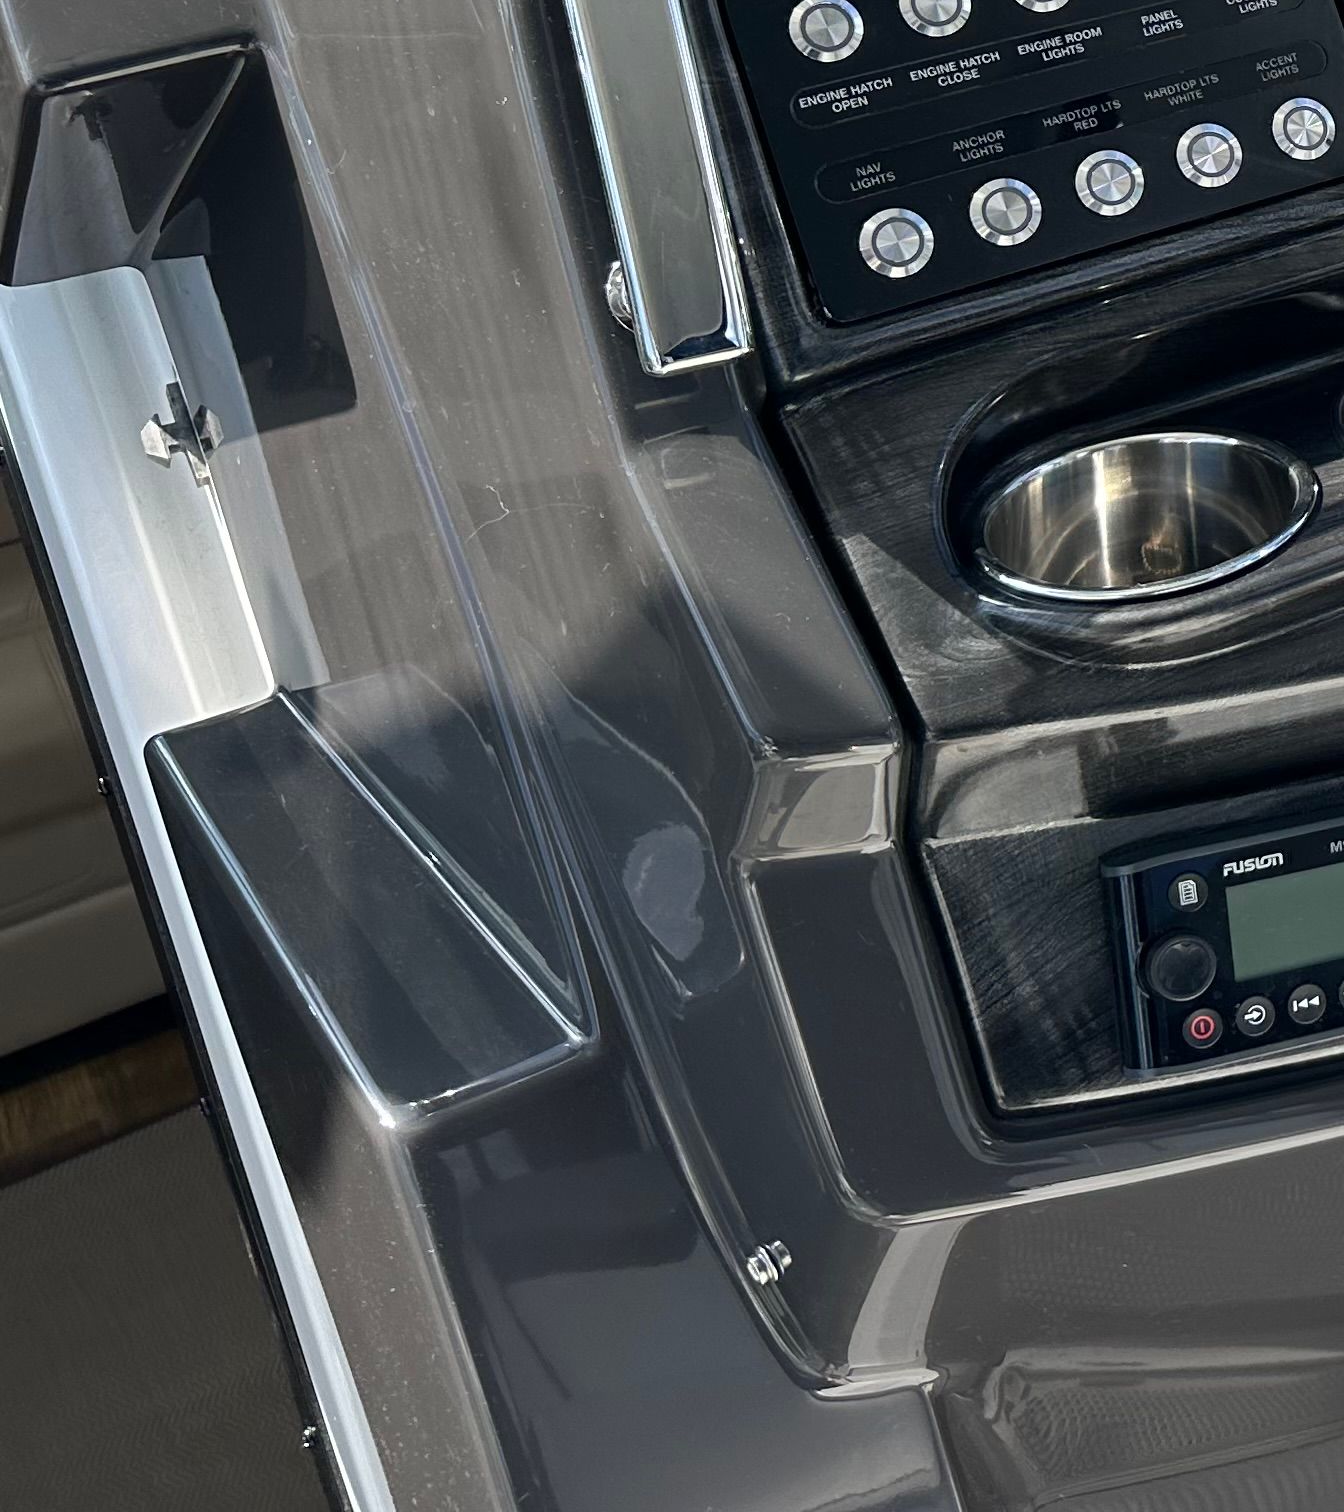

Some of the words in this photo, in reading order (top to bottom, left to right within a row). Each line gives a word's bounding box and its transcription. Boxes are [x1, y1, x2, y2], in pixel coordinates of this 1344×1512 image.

[1140, 9, 1178, 26] PANEL
[1142, 19, 1184, 37] LIGHTS
[1017, 36, 1063, 57] ENGINE
[1064, 26, 1103, 44] ROOM
[1042, 43, 1085, 62] LIGHTS
[1255, 52, 1298, 72] ACCENT
[910, 62, 957, 83] ENGINE
[959, 51, 1001, 70] HATCH
[1260, 63, 1300, 82] LIGHTS
[937, 68, 981, 88] CLOSE
[1143, 78, 1197, 101] HARDTOP
[1199, 73, 1220, 88] LTS
[798, 88, 850, 109] ENGINE
[850, 76, 894, 97] HATCH
[1168, 88, 1204, 107] WHITE
[831, 95, 869, 114] OPEN
[1042, 104, 1098, 129] HARDTOP
[1099, 99, 1122, 114] LTS
[1073, 117, 1099, 133] RED
[952, 129, 1006, 152] ANCHOR
[959, 142, 1004, 163] LIGHTS
[855, 161, 882, 177] NAV
[850, 170, 896, 192] LIGHTS
[1222, 852, 1284, 877] FUSION
